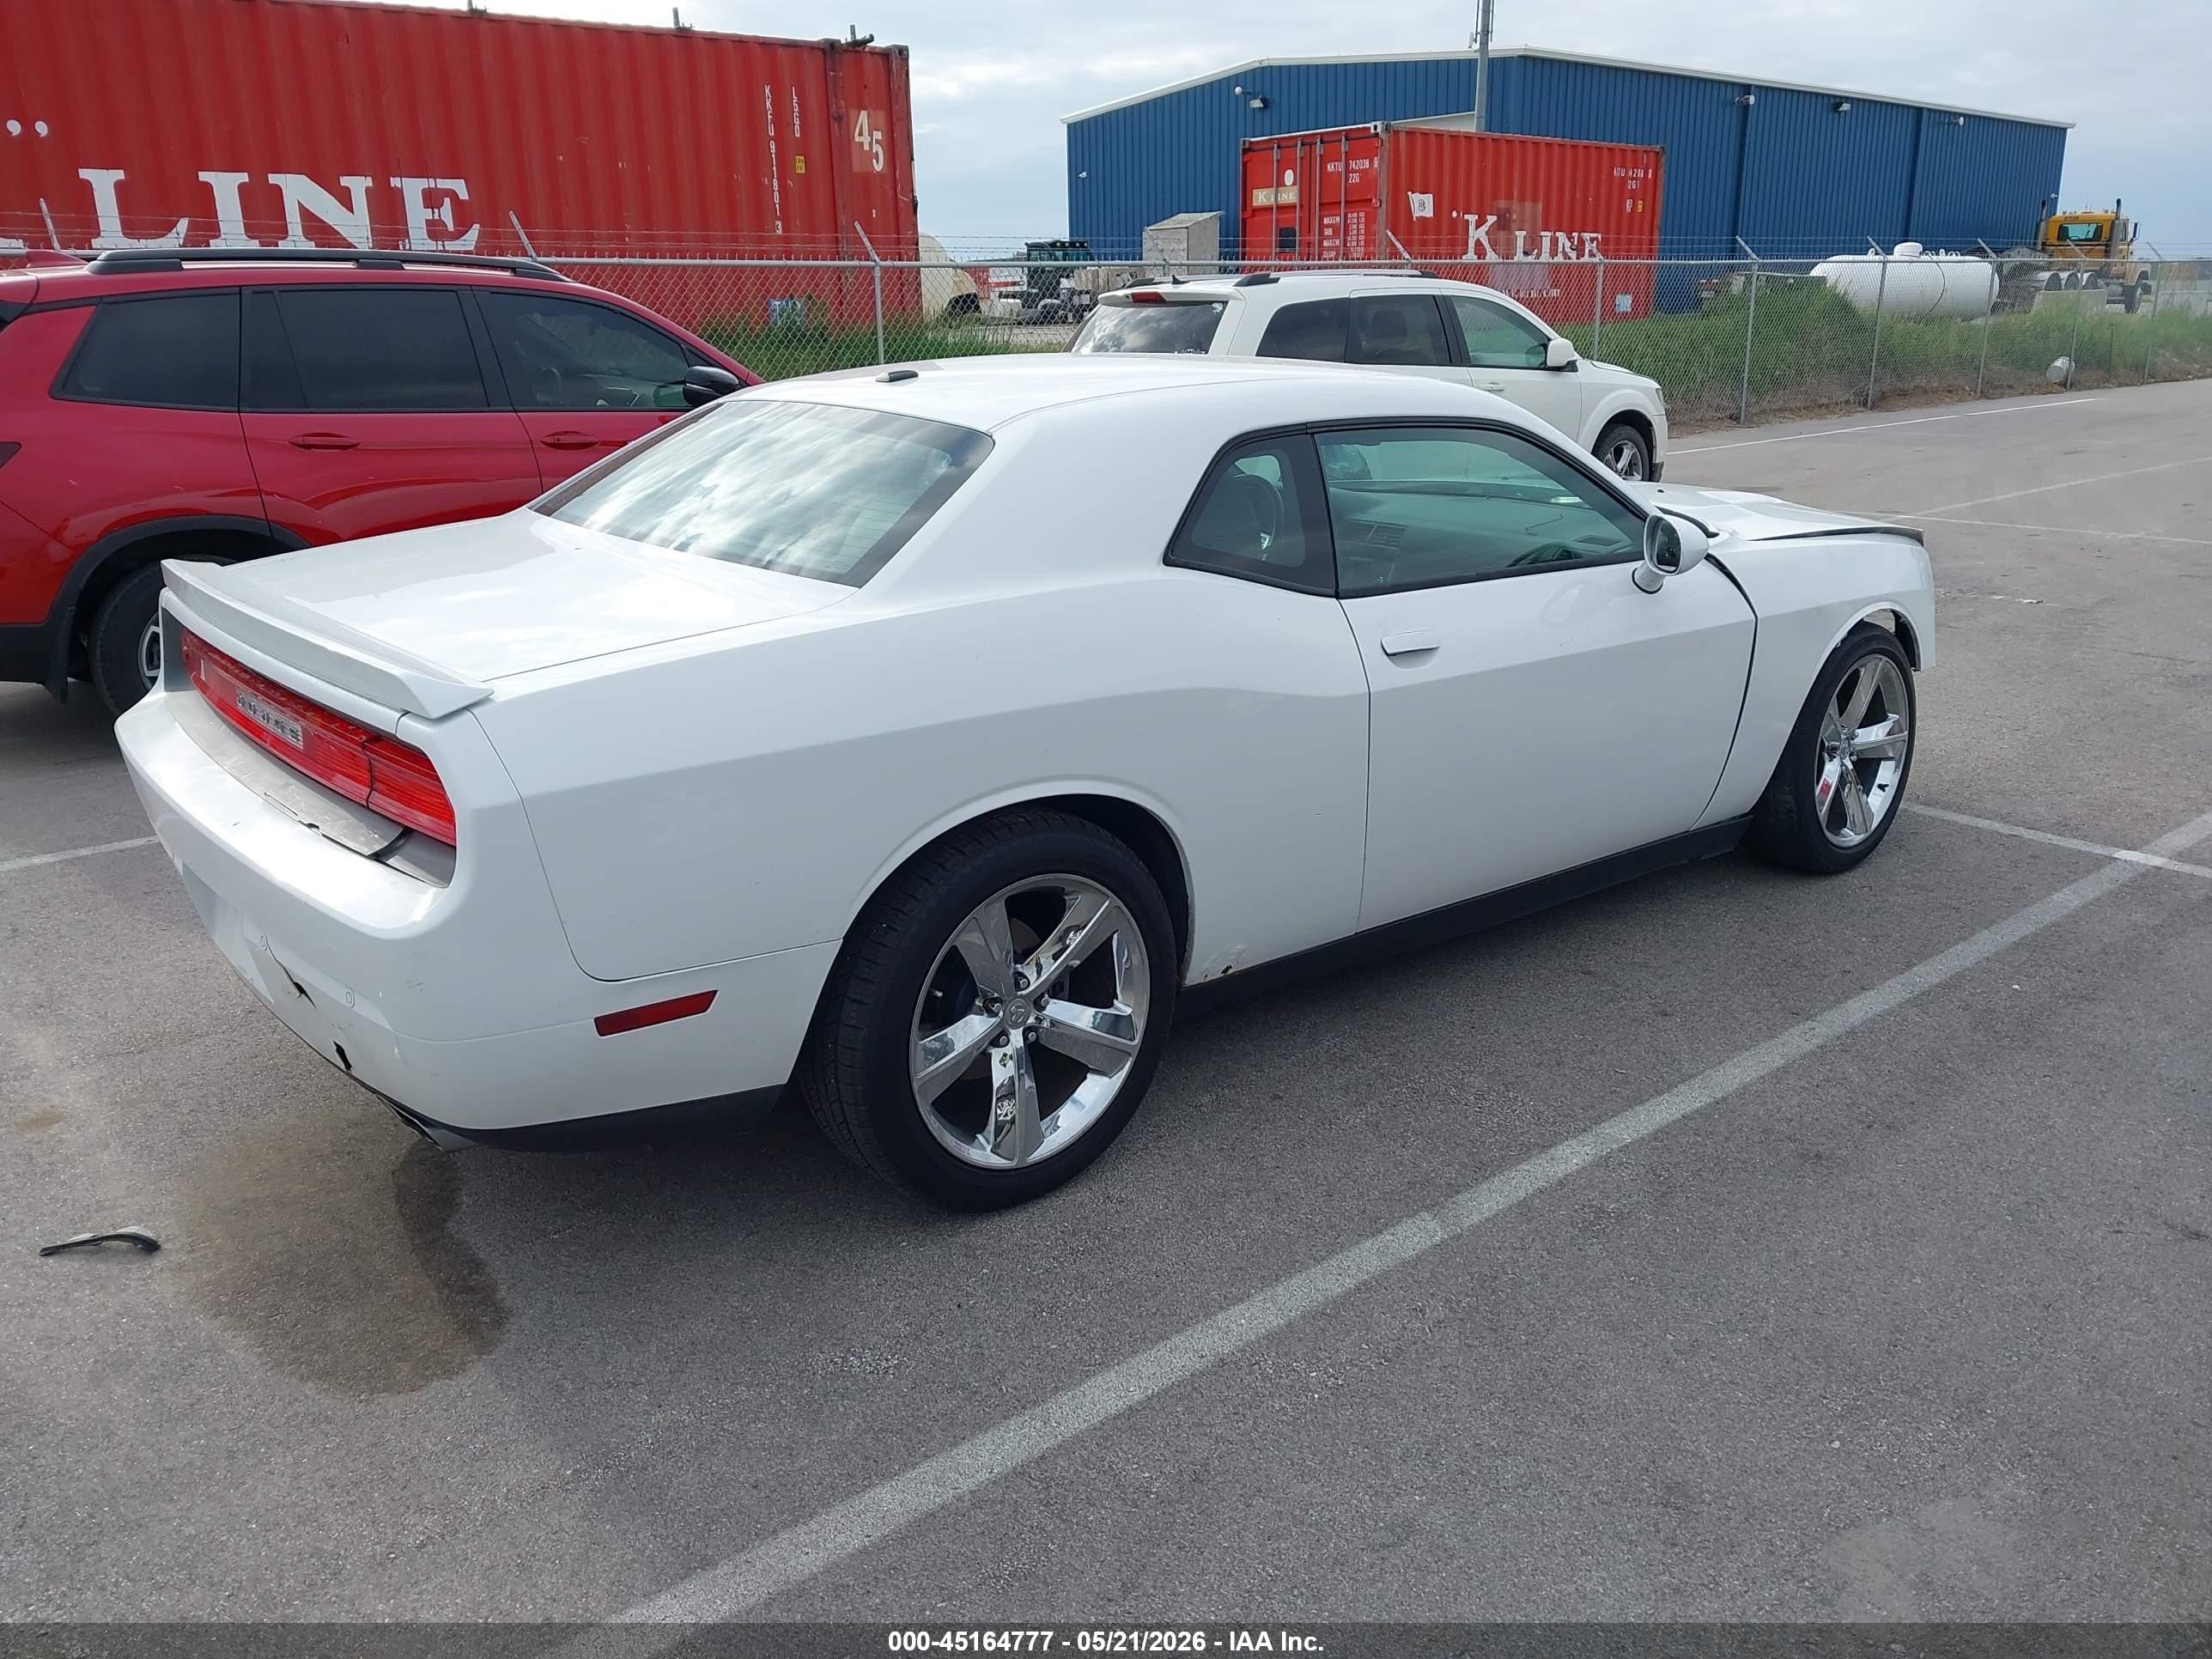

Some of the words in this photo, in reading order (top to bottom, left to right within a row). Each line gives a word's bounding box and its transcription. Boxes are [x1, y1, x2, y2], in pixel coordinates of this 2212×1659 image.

[764, 84, 775, 137] KKFU
[854, 109, 884, 172] 45
[769, 140, 781, 216] 911801
[78, 168, 481, 251] LINE
[775, 220, 783, 234] 3
[1514, 230, 1605, 261] LINE
